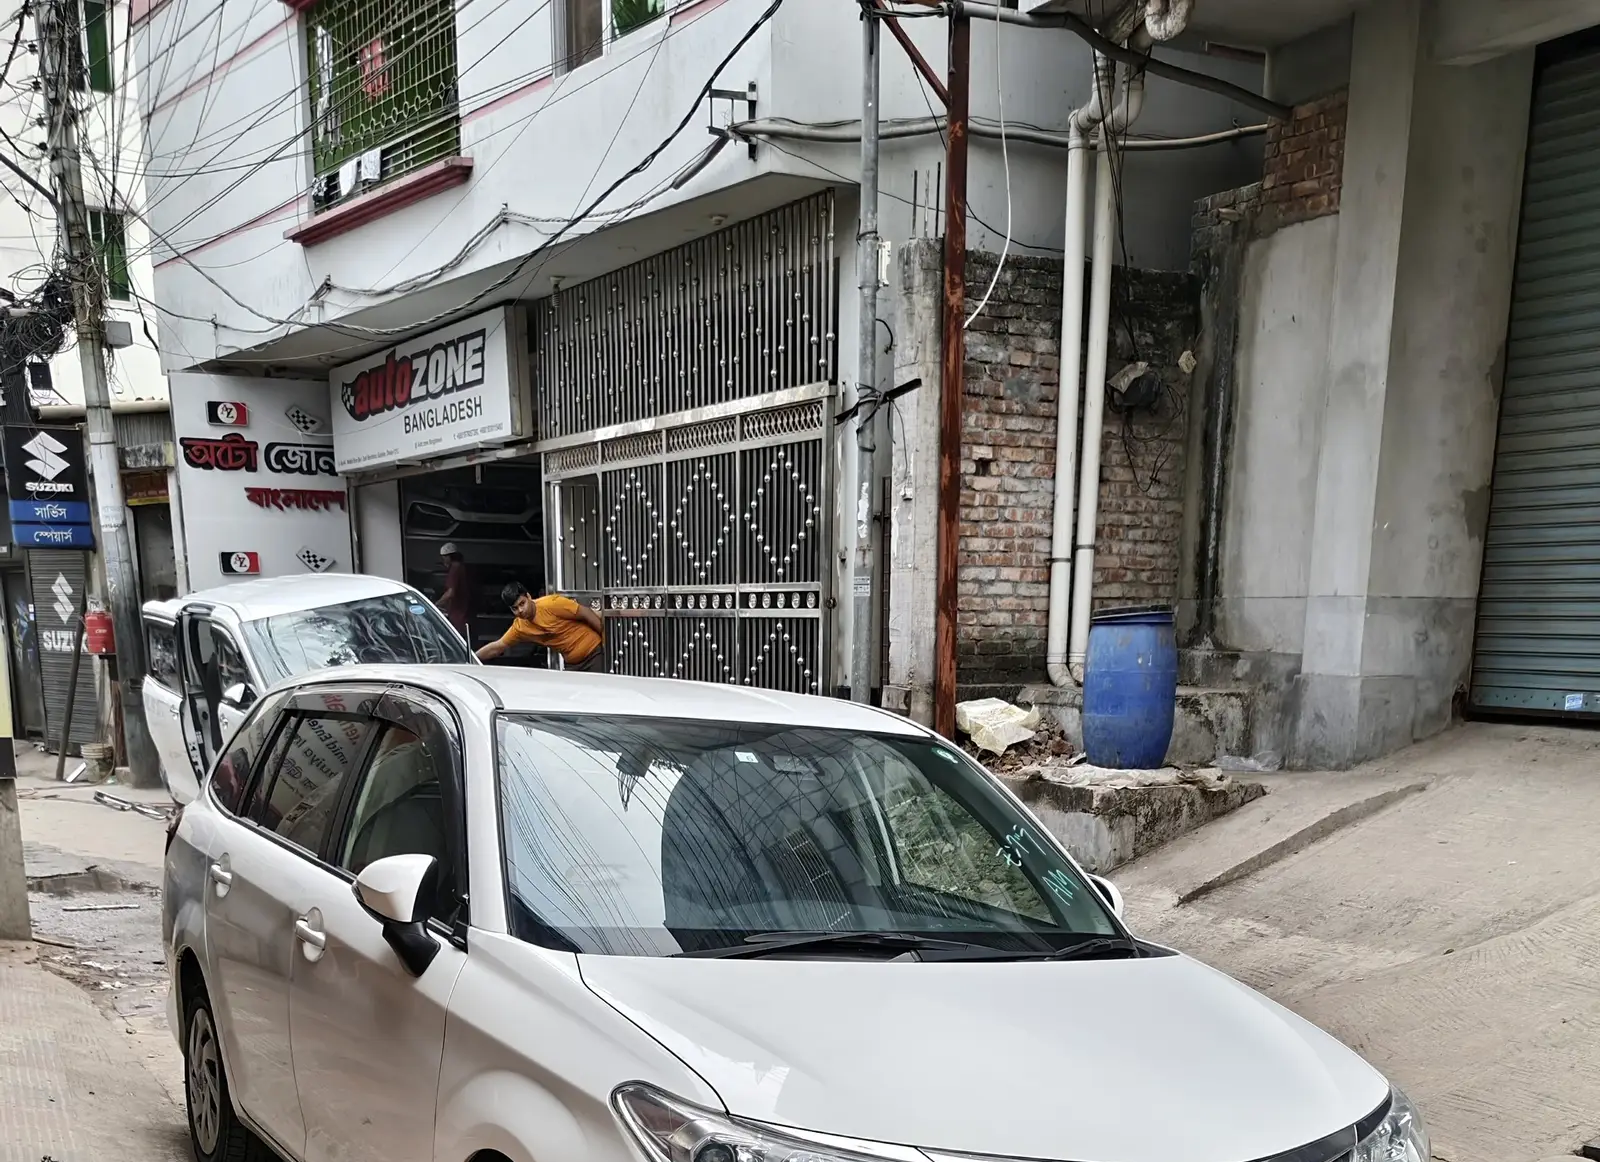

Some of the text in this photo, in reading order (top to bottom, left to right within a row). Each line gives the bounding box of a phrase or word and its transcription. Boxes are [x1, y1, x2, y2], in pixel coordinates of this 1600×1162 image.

[404, 396, 483, 434] BANGLADESH
[180, 433, 258, 472] অটো
[25, 482, 74, 492] SUZUKI
[244, 487, 346, 511] বাংলাদেশ
[34, 504, 67, 519] সার্ভিস
[34, 528, 72, 543] স্পেয়ার্স
